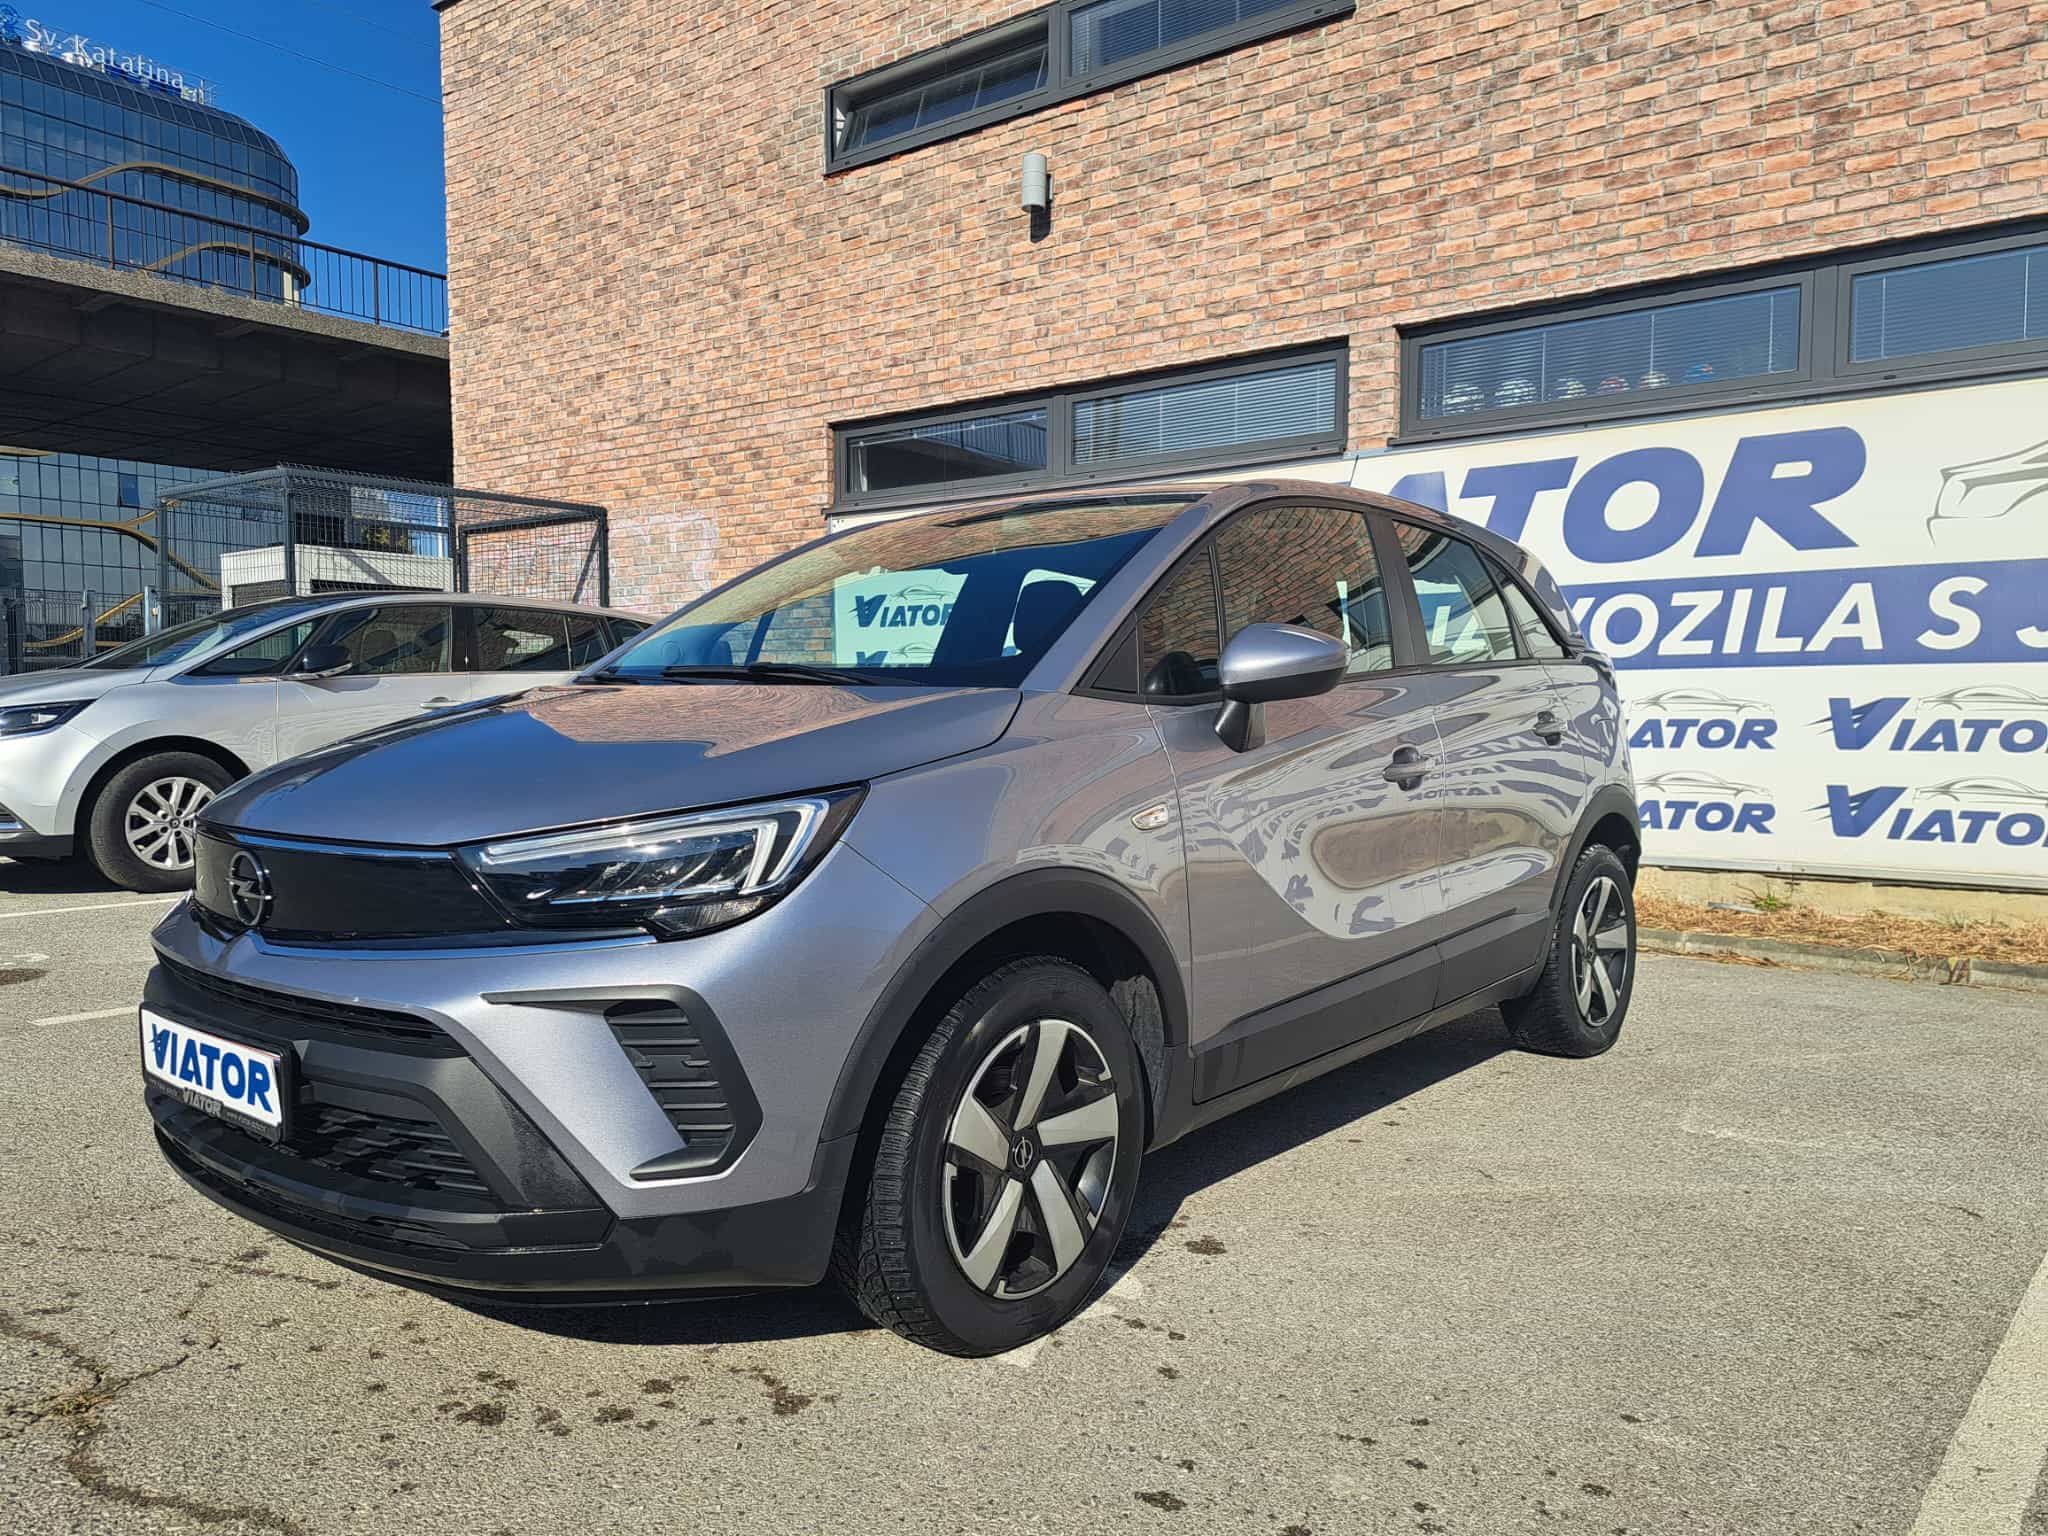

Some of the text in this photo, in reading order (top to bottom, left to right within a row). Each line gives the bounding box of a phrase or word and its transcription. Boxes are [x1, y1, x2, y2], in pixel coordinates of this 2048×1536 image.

[1388, 426, 1867, 563] TOR
[1916, 576, 1989, 650] S
[1626, 718, 1778, 749] ATOR
[1825, 697, 2048, 752] VIATO
[1638, 800, 1776, 834] ATOR
[1823, 785, 2048, 847] VIATO
[151, 1023, 273, 1113] VIATOR
[183, 1088, 222, 1117] VIATOR
